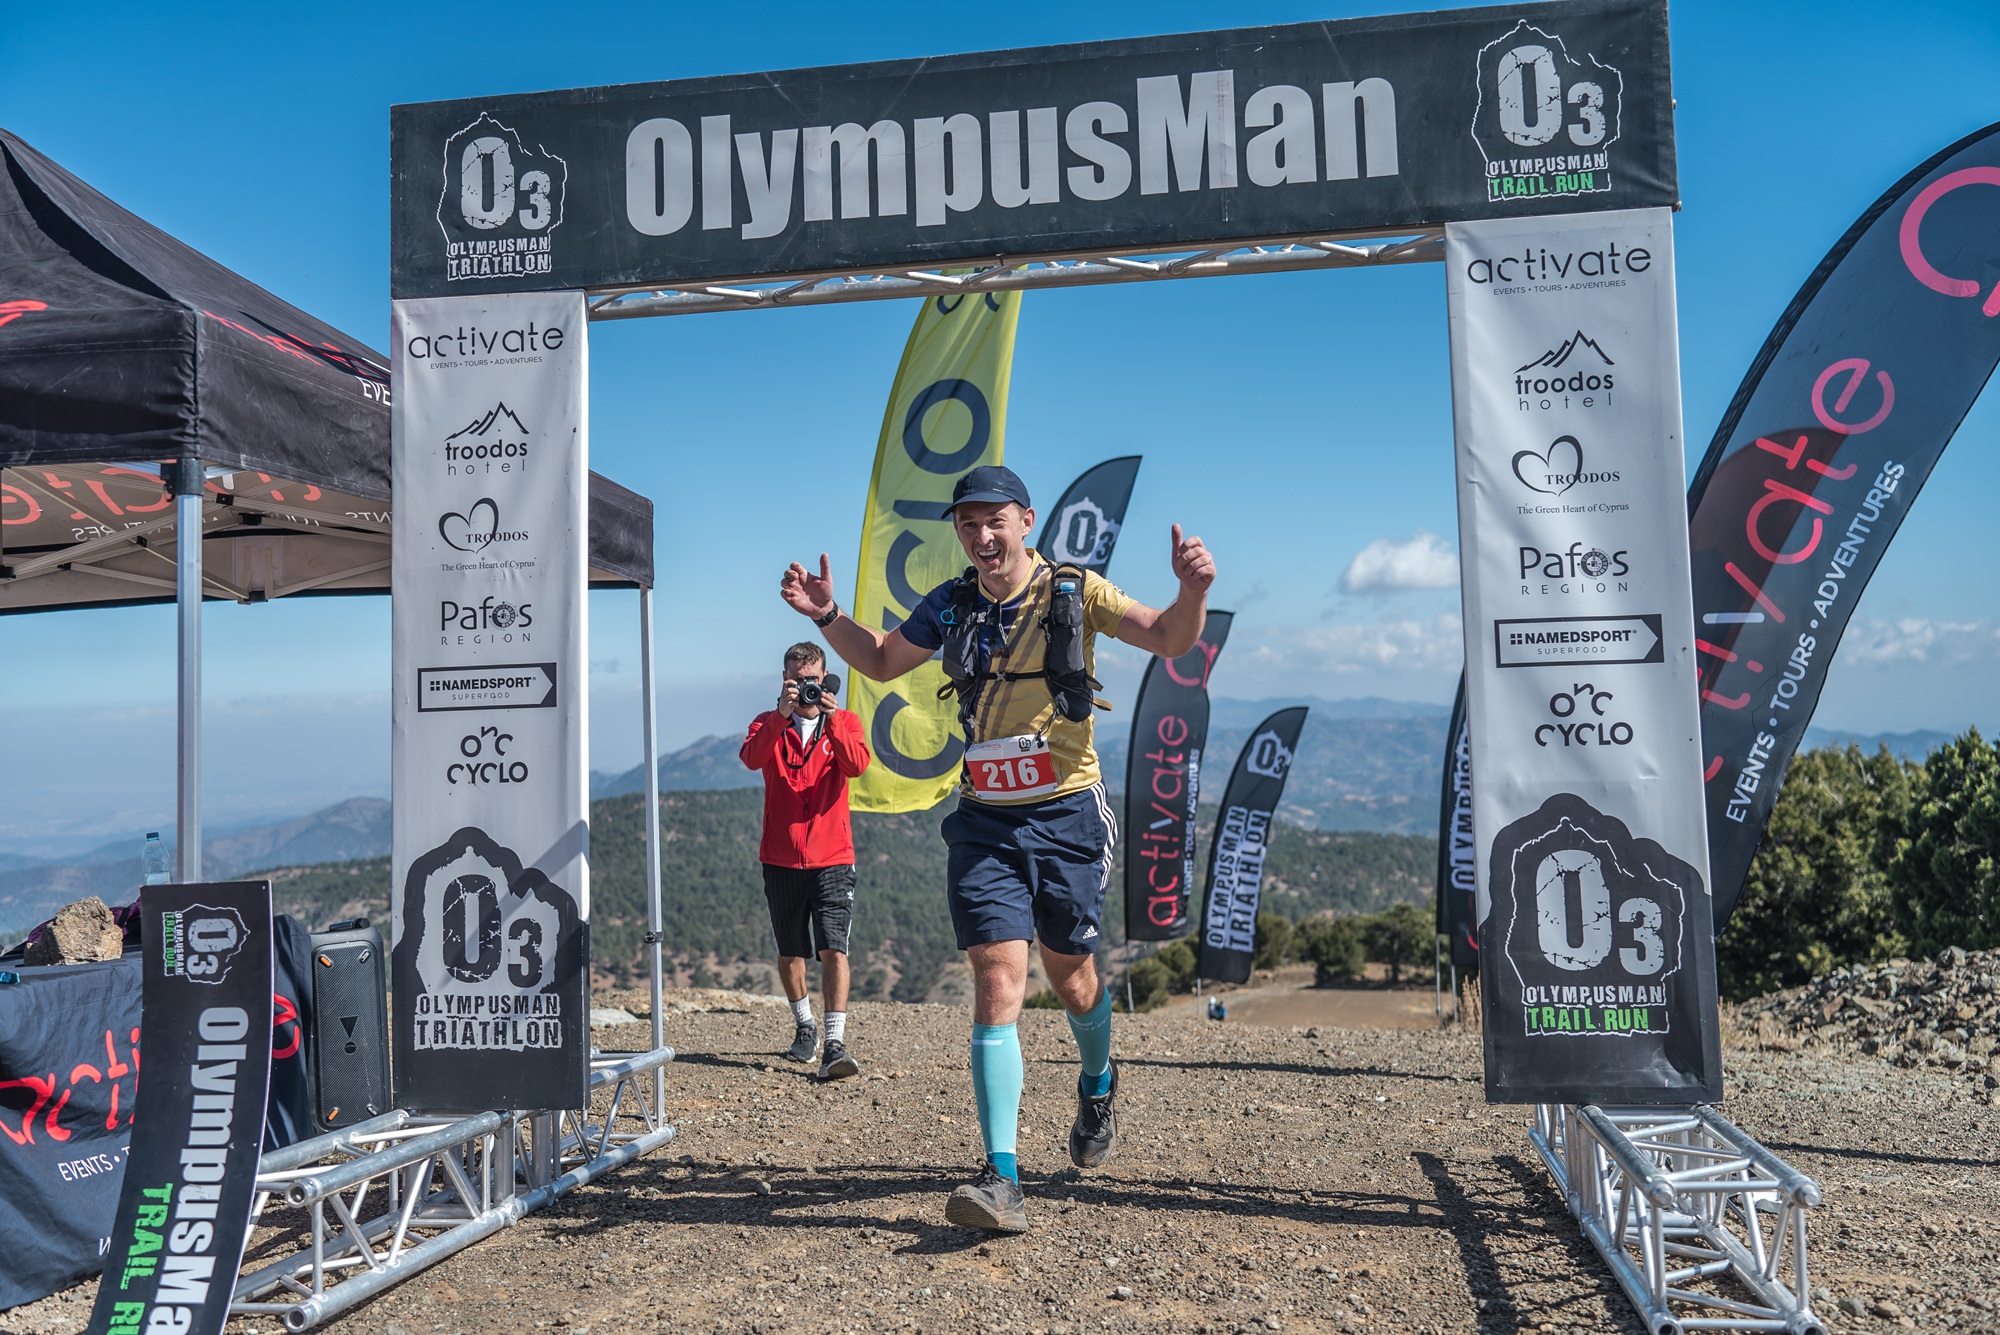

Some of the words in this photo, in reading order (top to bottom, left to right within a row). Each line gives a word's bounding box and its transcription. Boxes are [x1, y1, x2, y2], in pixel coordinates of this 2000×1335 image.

[625, 69, 1400, 240] OlympusMan
[1489, 153, 1605, 175] OLYMPUSMAN
[1490, 176, 1548, 196] TRAIL
[1555, 172, 1594, 193] RUN
[450, 237, 548, 256] OLYMPUSMAN
[450, 254, 549, 276] TRIATHLON
[1493, 286, 1526, 295] EVENTS
[1534, 284, 1563, 293] TOURS
[1569, 280, 1627, 290] ADVENTURES
[430, 362, 458, 370] EVENTS
[464, 359, 489, 367] TOURS
[494, 356, 543, 366] ADVENTURES
[1515, 371, 1614, 395] troodos
[1519, 393, 1612, 411] hotel
[445, 439, 528, 461] troodos
[448, 459, 526, 476] hotel
[1544, 471, 1621, 485] TROODOS
[1517, 505, 1533, 515] The
[1535, 505, 1560, 515] Green
[1562, 504, 1586, 514] Heart
[1587, 503, 1597, 513] of
[1598, 502, 1630, 514] Cyprus
[465, 531, 529, 544] TROODOS
[441, 563, 455, 572] The
[456, 562, 477, 571] Green
[479, 561, 499, 570] Heart
[499, 559, 508, 569] of
[509, 559, 536, 570] Cyprus
[1519, 541, 1630, 580] Pafos
[1521, 582, 1629, 595] REGION
[441, 596, 533, 631] Pafos
[441, 633, 532, 646] REGION
[1537, 646, 1607, 655] SUPERFOOD
[1726, 730, 1776, 823] EVENTS
[1770, 632, 1816, 711] TOURS
[1814, 460, 1905, 619] ADVENTURES
[452, 692, 511, 701] SUPERFOOD
[1535, 722, 1634, 747] CYCLO
[446, 761, 529, 785] CYCLO
[982, 758, 1040, 788] 216
[1209, 808, 1246, 946] OLYMPUSMAN
[1230, 812, 1268, 951] TRIATHLON
[165, 913, 175, 943] TRAIL
[175, 911, 185, 976] OLYMPUSMAN
[166, 948, 175, 967] RUN
[419, 994, 558, 1015] OLYMPUSMAN
[1526, 985, 1662, 1004] OLYMPUSMAN
[1528, 1007, 1597, 1030] TRAIL
[1604, 1008, 1649, 1030] RUN
[417, 1019, 560, 1046] TRIATHLON
[58, 1153, 114, 1181] EVENTS
[120, 1183, 174, 1290] TRAIL
